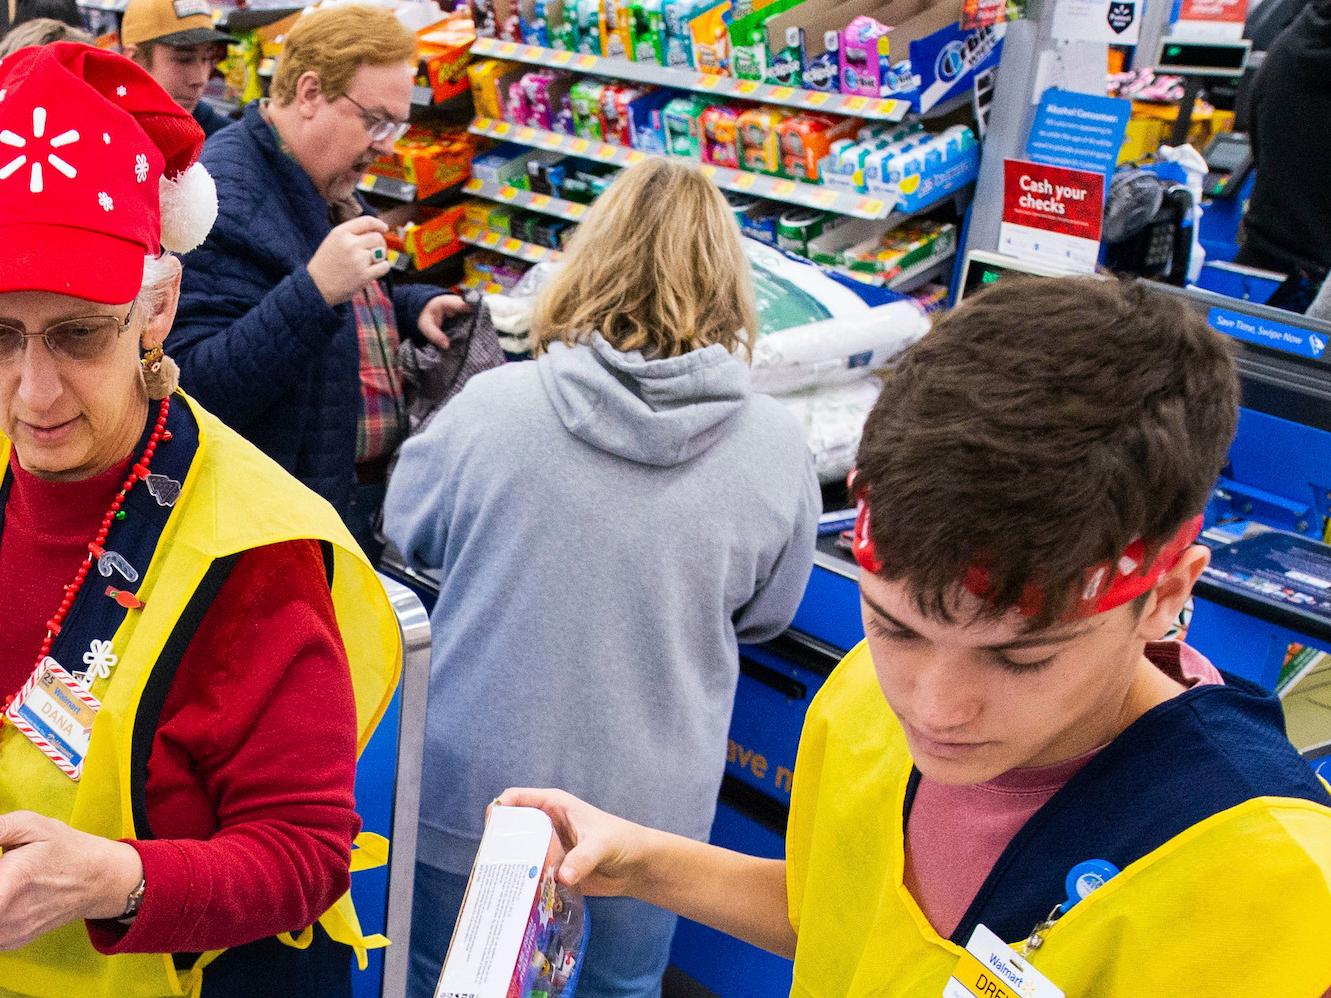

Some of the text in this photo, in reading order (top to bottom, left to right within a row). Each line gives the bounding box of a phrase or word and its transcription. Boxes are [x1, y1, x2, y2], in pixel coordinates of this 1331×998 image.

[1019, 175, 1087, 201] Cash your
[1019, 194, 1066, 215] checks
[1283, 332, 1303, 345] Now
[43, 672, 56, 685] 25
[54, 686, 82, 716] Walmart
[40, 701, 74, 737] DANA
[726, 738, 768, 778] ave
[990, 953, 1023, 988] Walmart
